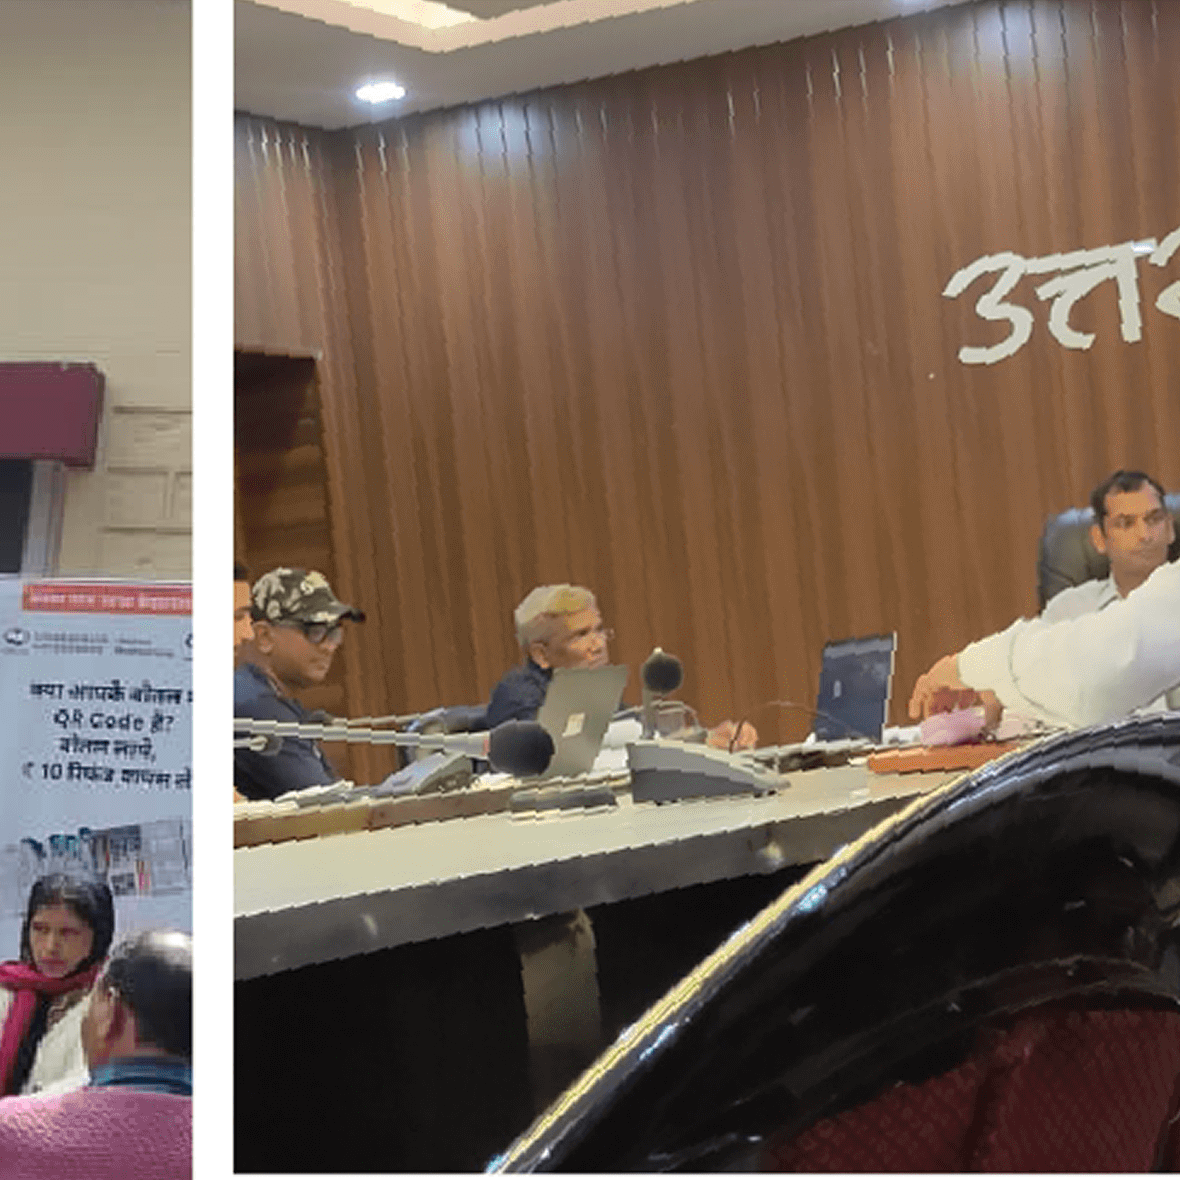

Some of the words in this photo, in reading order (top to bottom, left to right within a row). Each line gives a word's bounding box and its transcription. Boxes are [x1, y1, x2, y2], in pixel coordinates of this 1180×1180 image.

[30, 683, 64, 700] क्या
[54, 708, 83, 730] QR
[90, 713, 145, 732] Code
[59, 733, 110, 755] बोतल
[42, 763, 62, 780] 10
